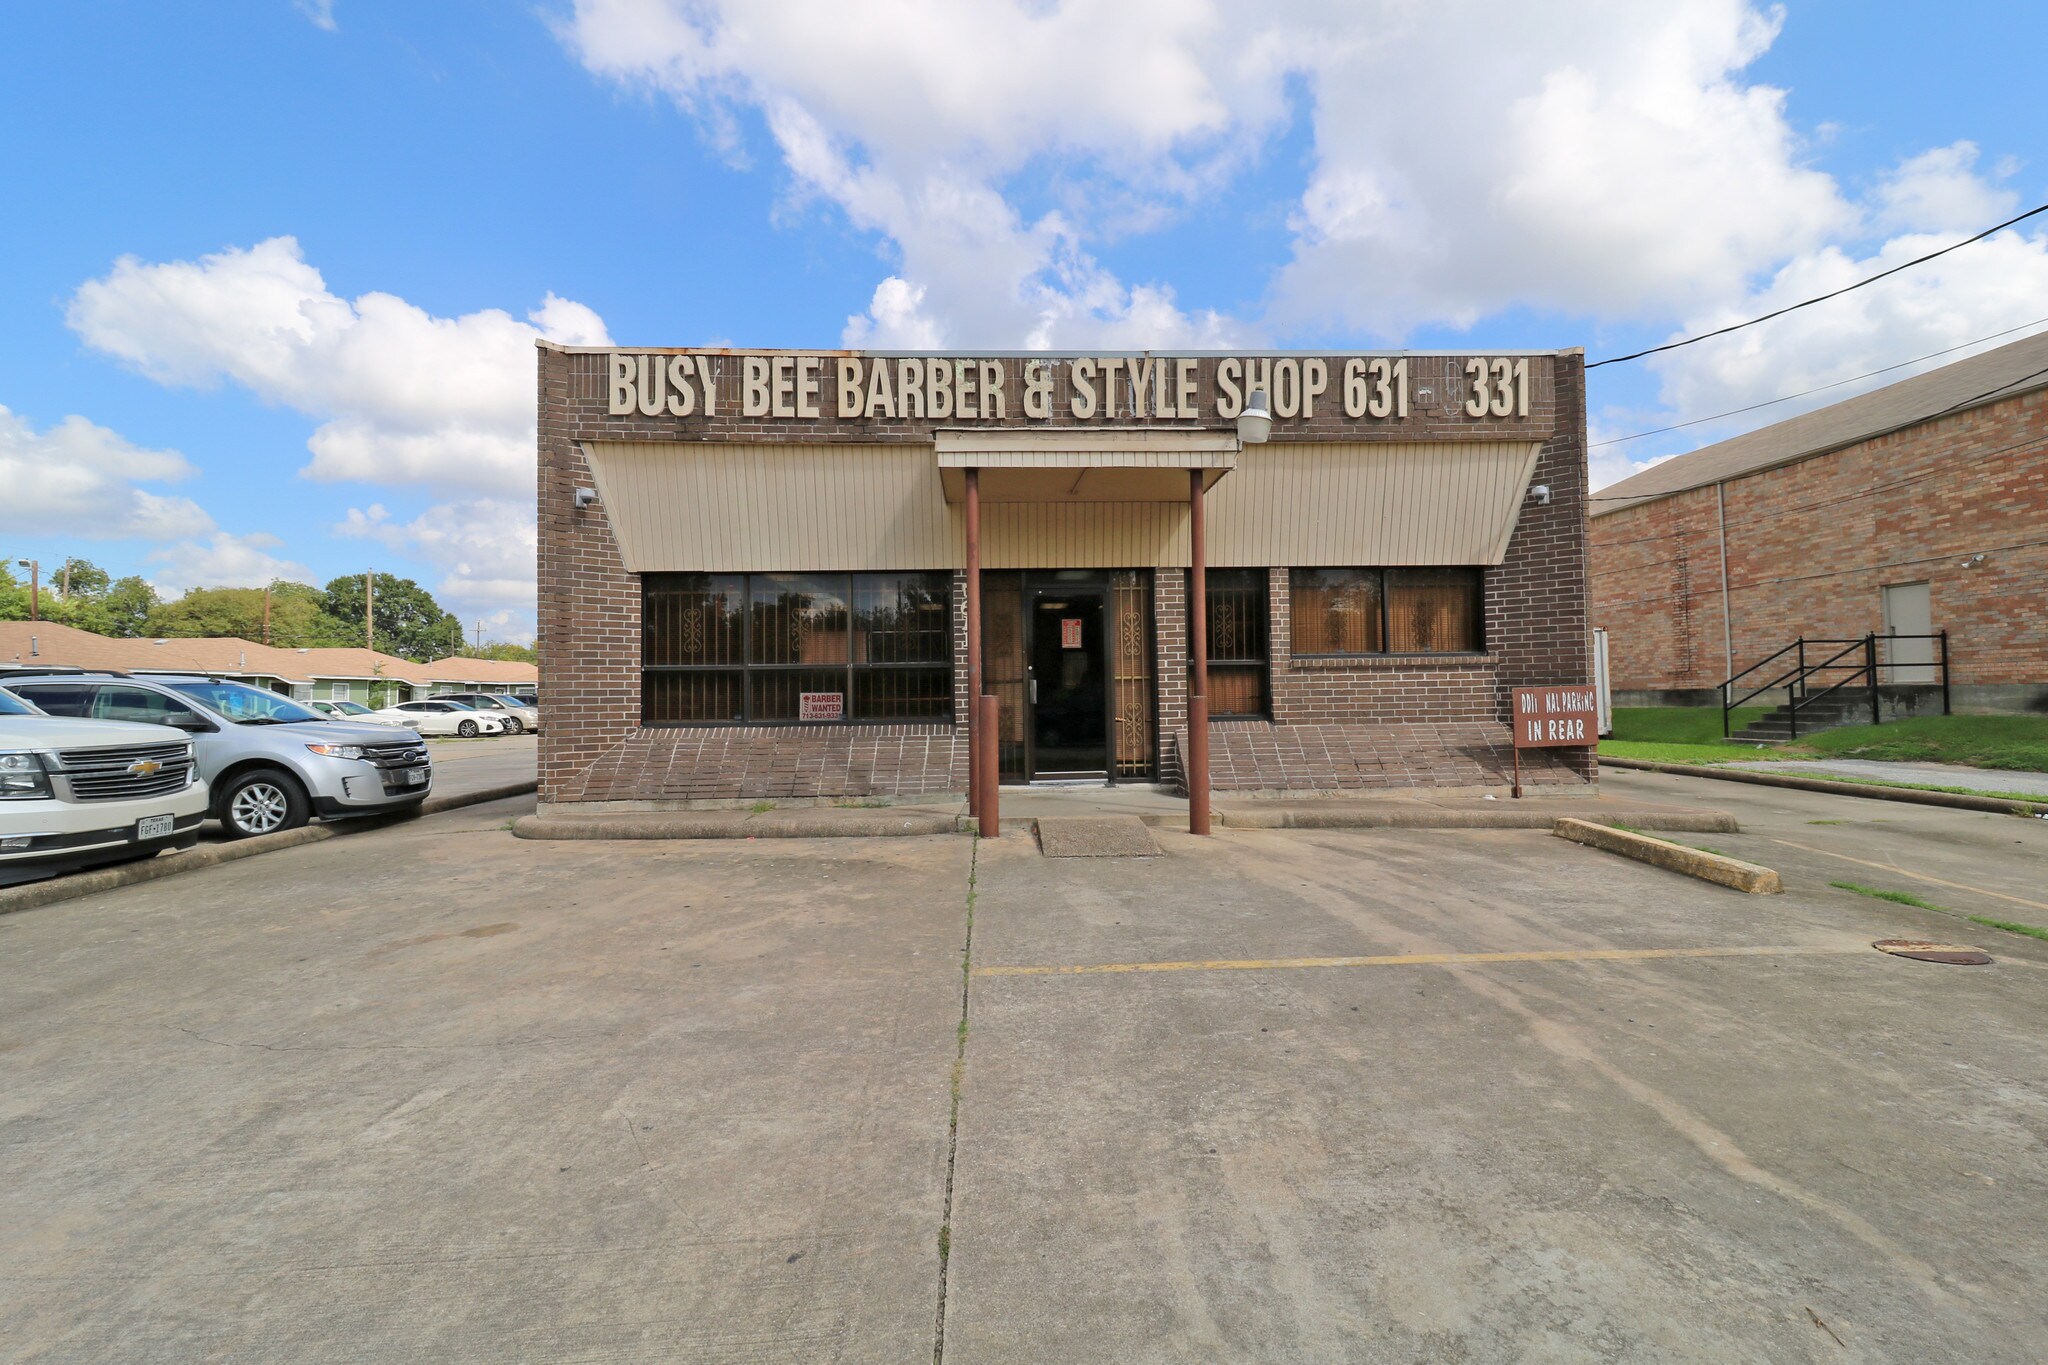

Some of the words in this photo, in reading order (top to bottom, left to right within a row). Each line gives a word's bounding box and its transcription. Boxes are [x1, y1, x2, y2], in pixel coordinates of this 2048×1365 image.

[608, 354, 718, 417] BUSY
[742, 357, 820, 419] BEE
[837, 358, 1005, 419] BARBER
[1023, 359, 1054, 419] &
[1071, 358, 1199, 419] STYLE
[1217, 358, 1328, 419] SHOP
[1344, 358, 1408, 419] 631
[811, 695, 841, 703] BARBER
[811, 704, 841, 712] WANTED
[1528, 720, 1542, 741] IN
[1549, 719, 1584, 741] REAR
